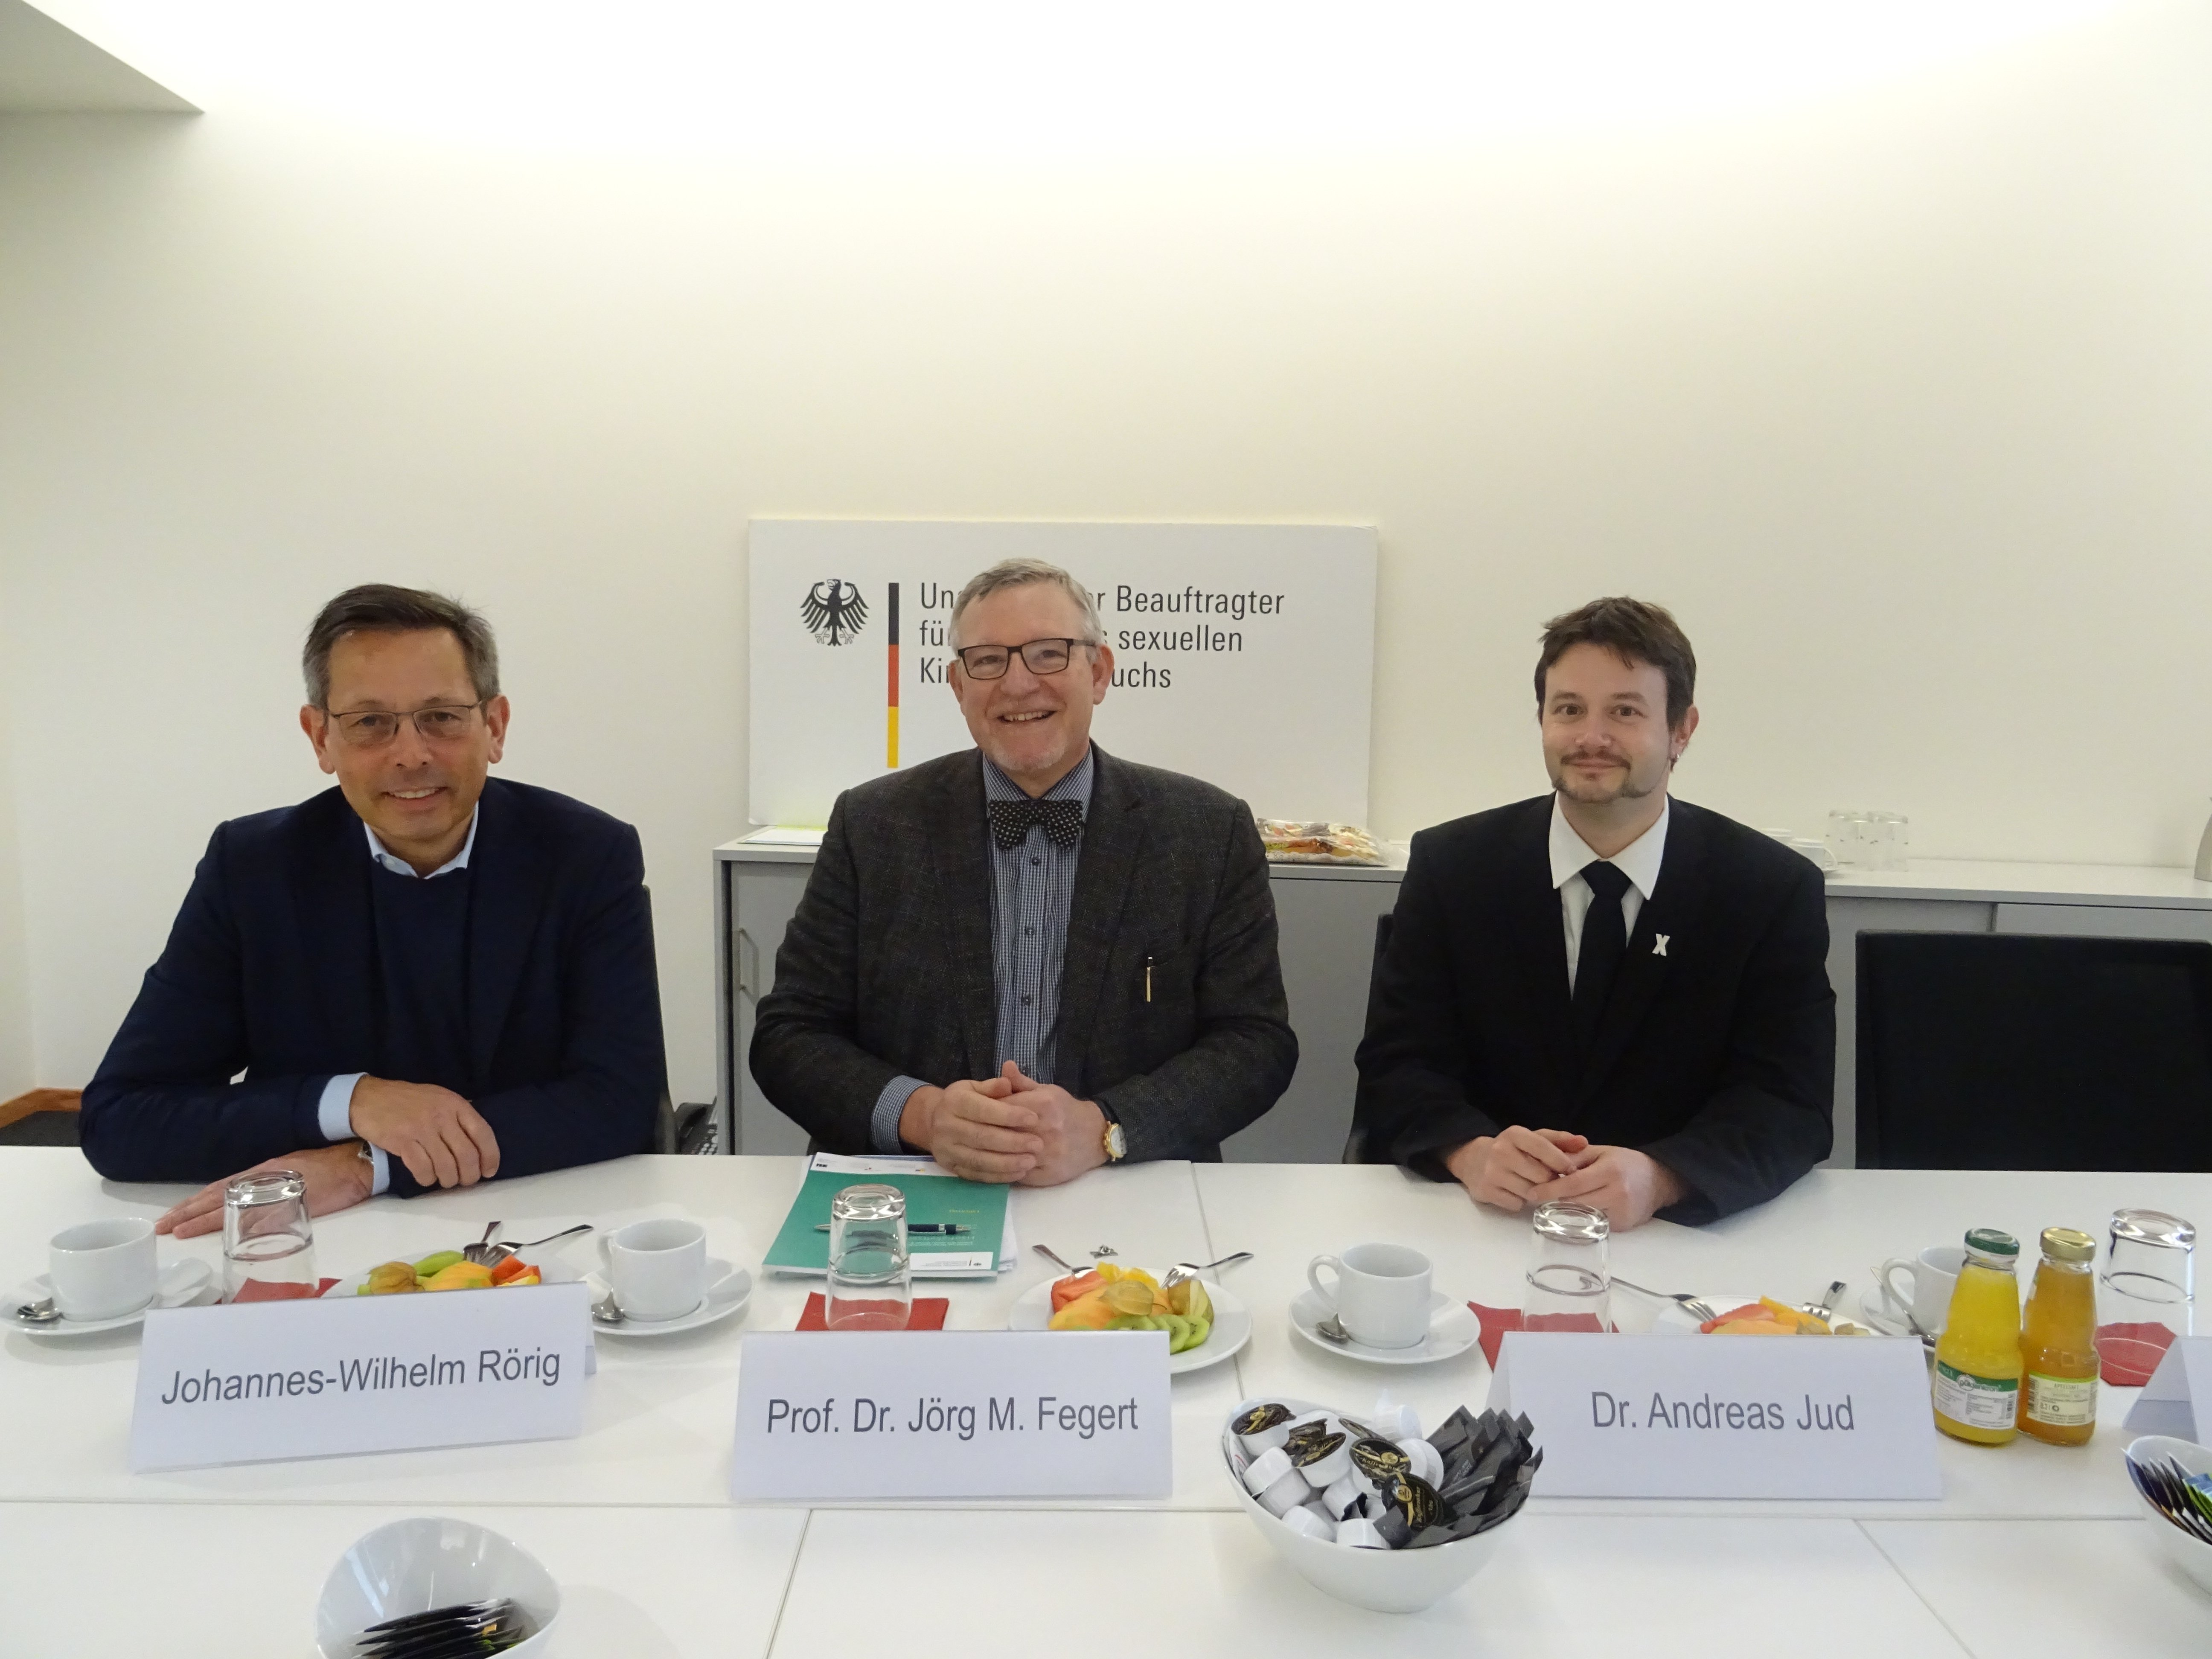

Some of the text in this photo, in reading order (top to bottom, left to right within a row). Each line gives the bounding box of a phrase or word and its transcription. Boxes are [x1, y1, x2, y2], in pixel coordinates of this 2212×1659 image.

[921, 582, 962, 609] Un
[1117, 585, 1285, 620] Beauftragter
[1118, 624, 1243, 652] sexuellen
[162, 1347, 560, 1405] Johannes-Wilhelm Rörig
[767, 1397, 1138, 1441] Prof. Dr. Jörg M. Fegert
[1592, 1391, 1854, 1431] Dr. Andreas Jud
